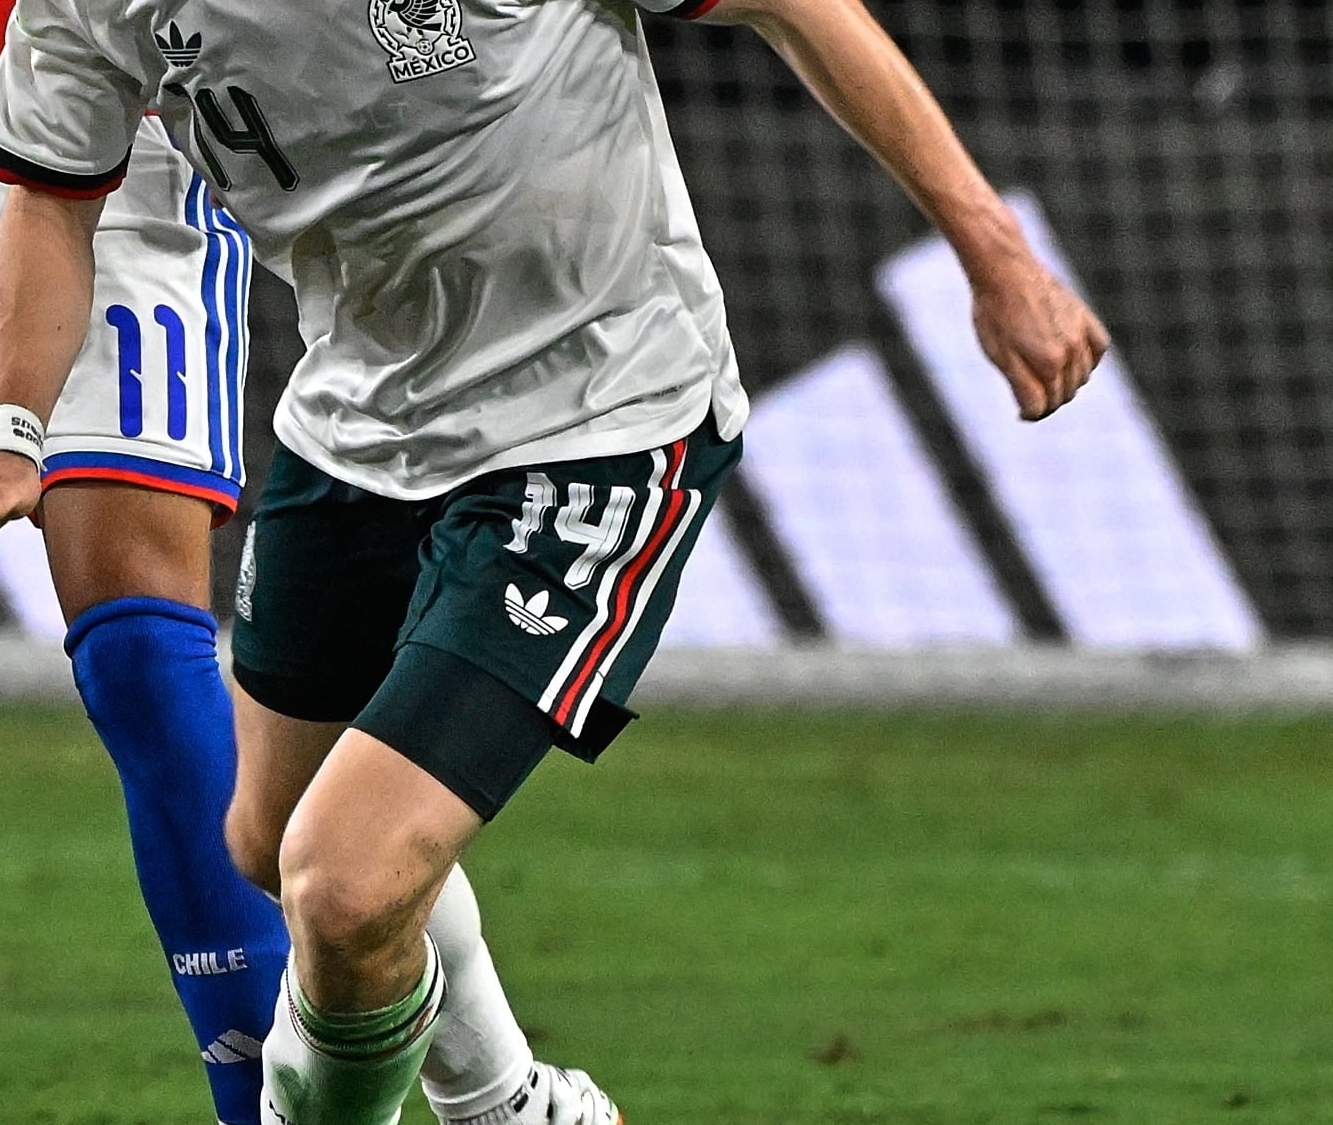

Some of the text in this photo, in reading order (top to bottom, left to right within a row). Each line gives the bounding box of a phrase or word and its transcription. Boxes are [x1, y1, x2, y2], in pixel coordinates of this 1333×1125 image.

[392, 44, 470, 79] MÉXICO
[105, 303, 188, 442] 11
[502, 472, 636, 591] 14
[172, 947, 249, 975] CHILE
